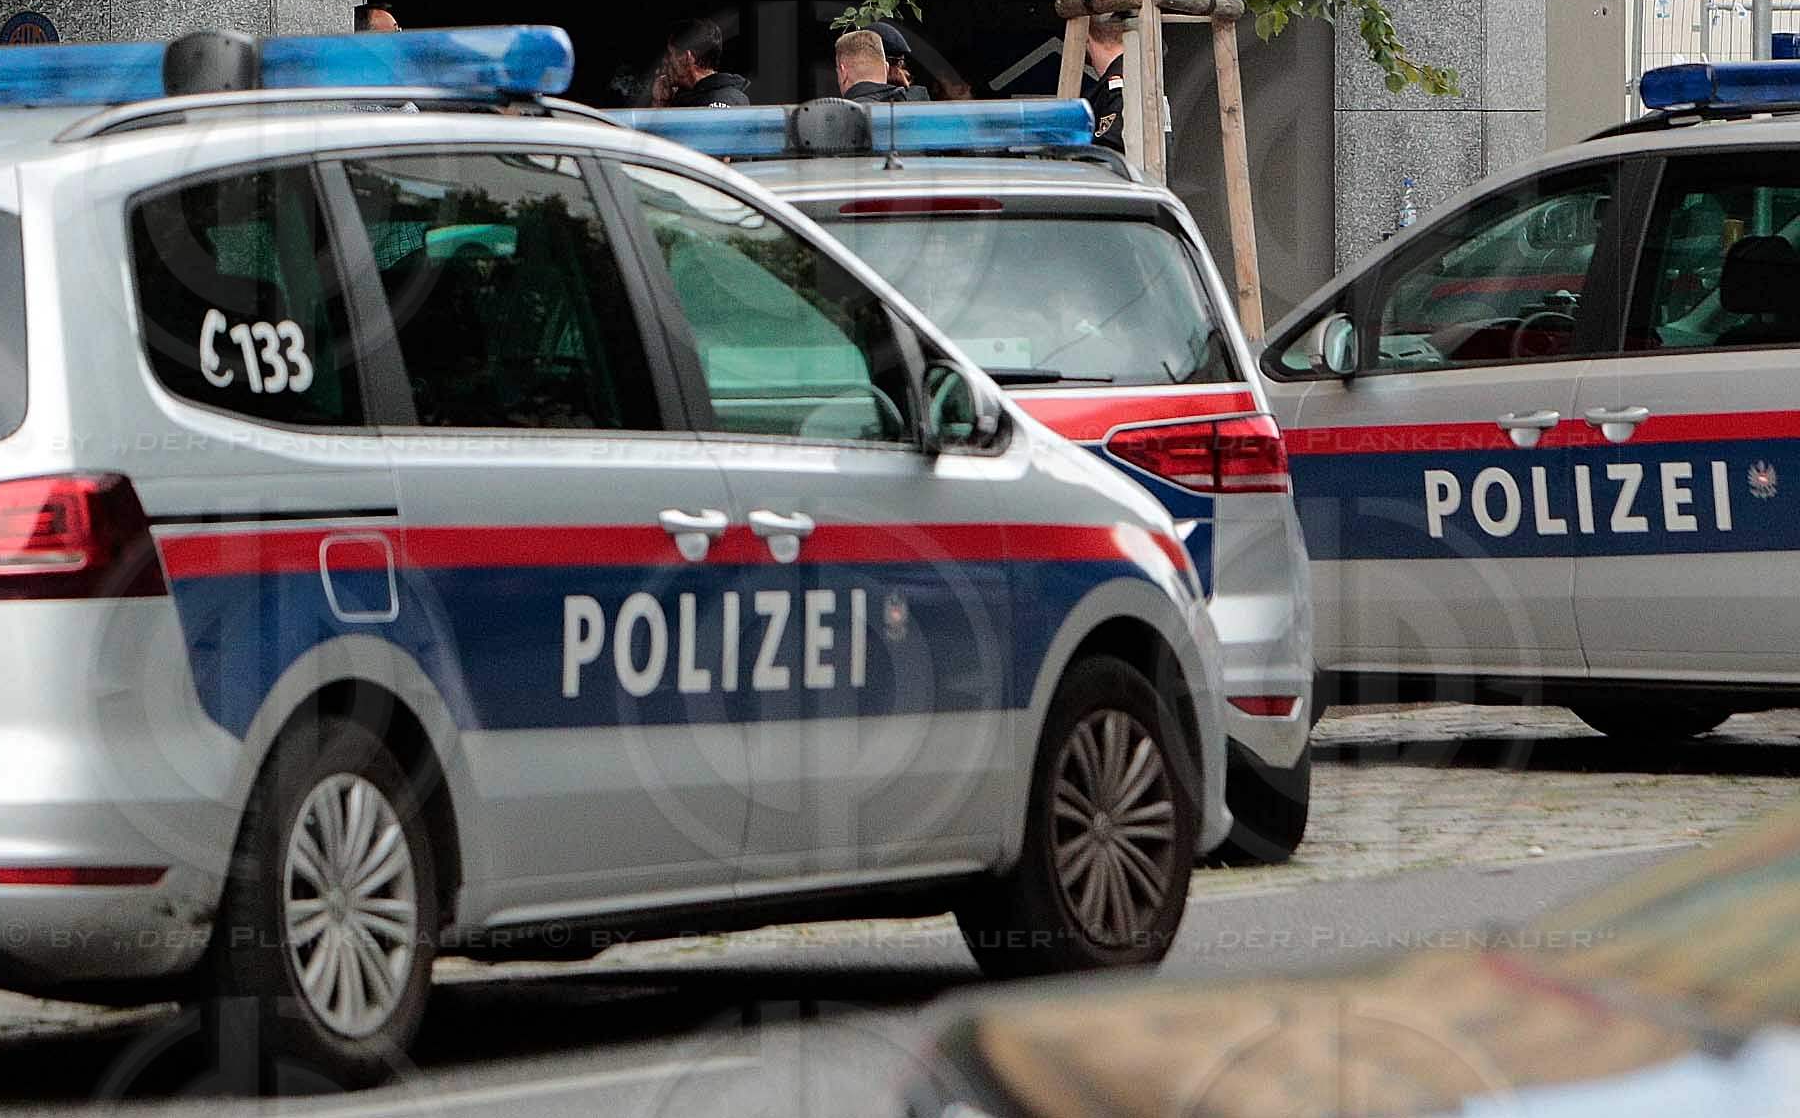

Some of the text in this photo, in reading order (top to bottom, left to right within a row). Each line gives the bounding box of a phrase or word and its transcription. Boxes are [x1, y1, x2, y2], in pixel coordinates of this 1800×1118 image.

[229, 319, 314, 394] 133
[1423, 459, 1734, 539] POLIZEI
[561, 588, 868, 698] POLIZEI
